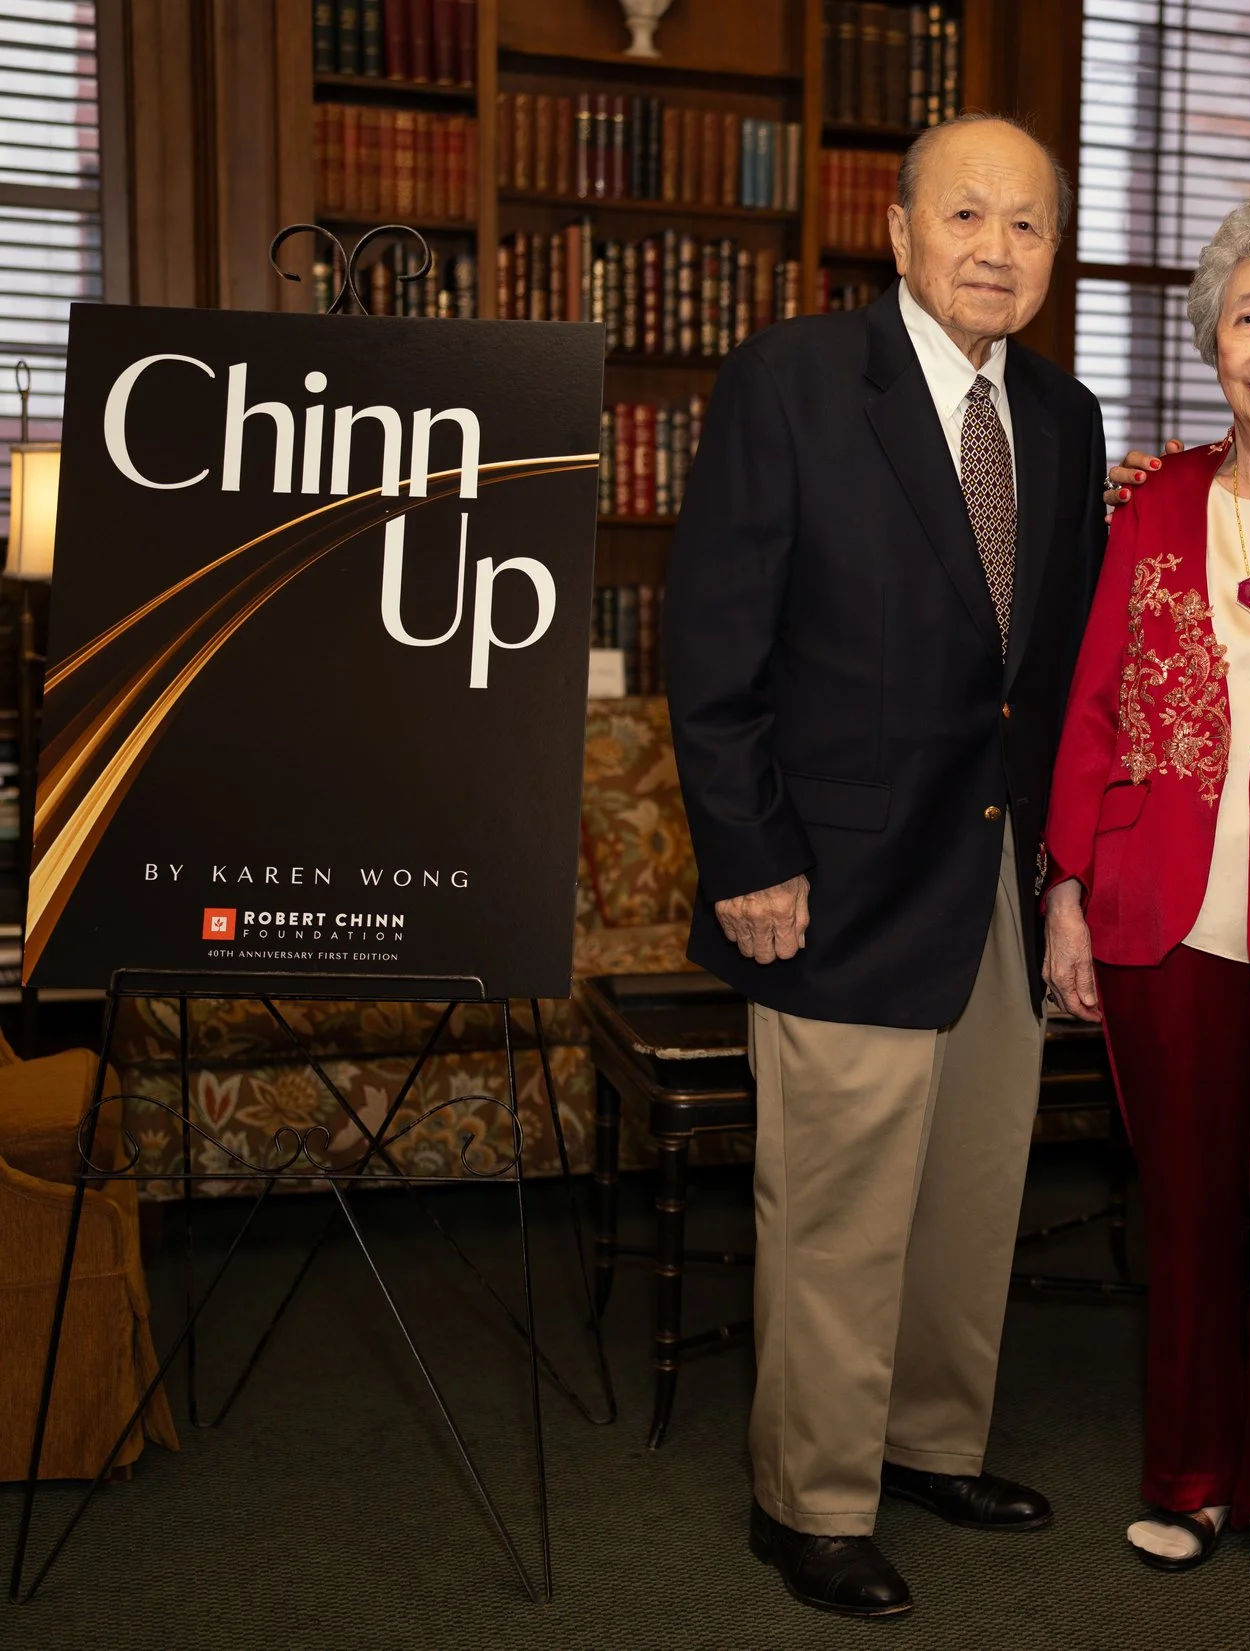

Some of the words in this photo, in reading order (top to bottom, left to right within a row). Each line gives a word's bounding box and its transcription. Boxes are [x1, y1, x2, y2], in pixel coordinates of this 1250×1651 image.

[103, 353, 481, 500] Chinn
[381, 510, 557, 689] Up
[144, 863, 184, 882] BY
[212, 865, 332, 886] KAREN
[360, 868, 469, 888] WONG
[243, 911, 327, 927] ROBERT
[335, 913, 405, 928] CHINN
[243, 929, 403, 942] FOUNDATION
[207, 949, 234, 958] 40TH
[238, 950, 314, 960] ANNIVERSARY
[318, 951, 349, 960] FIRST
[353, 952, 399, 961] EDITION
